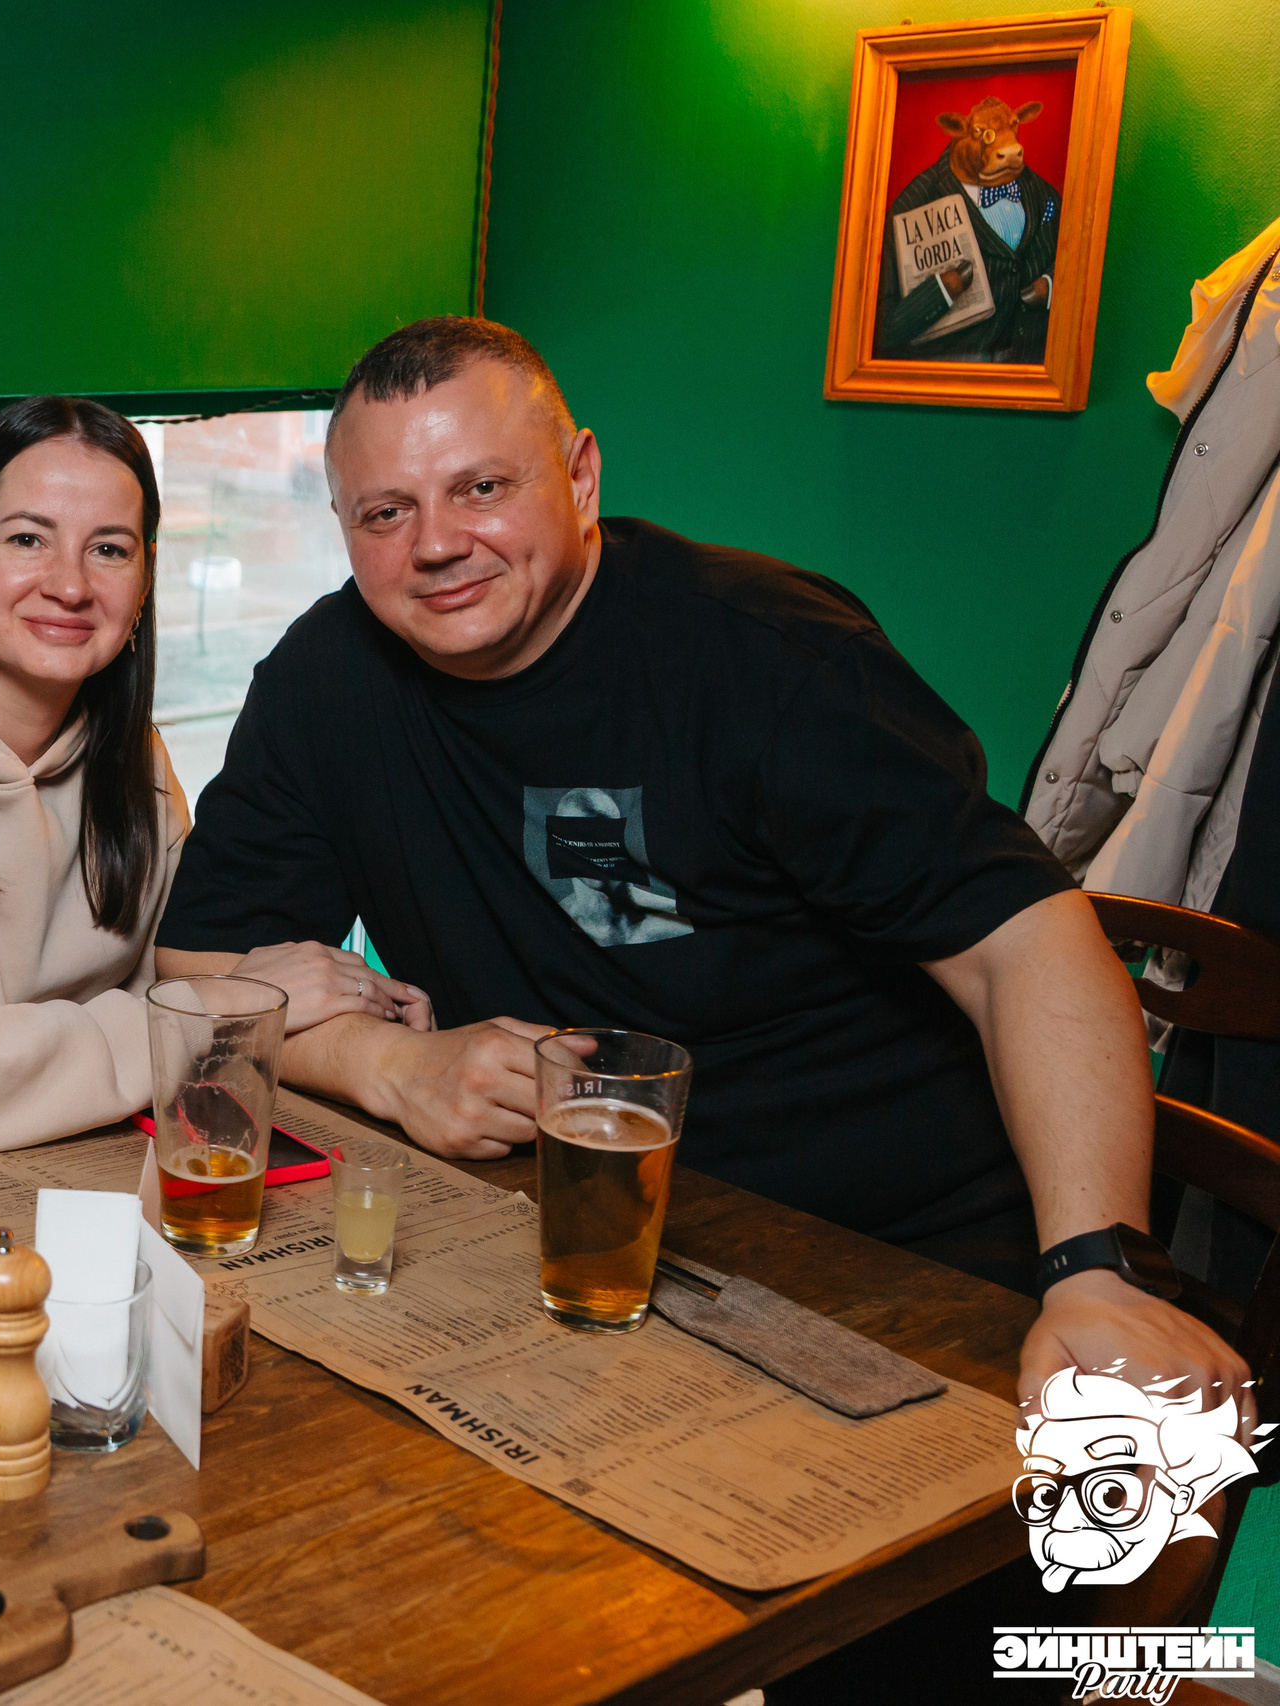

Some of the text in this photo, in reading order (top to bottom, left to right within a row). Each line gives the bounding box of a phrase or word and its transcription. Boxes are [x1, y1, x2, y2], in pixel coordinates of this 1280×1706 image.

[902, 203, 963, 245] LA VACA
[914, 236, 962, 271] GORDA
[218, 1235, 336, 1271] IRISHMAN
[404, 1383, 541, 1466] IRISHMAN
